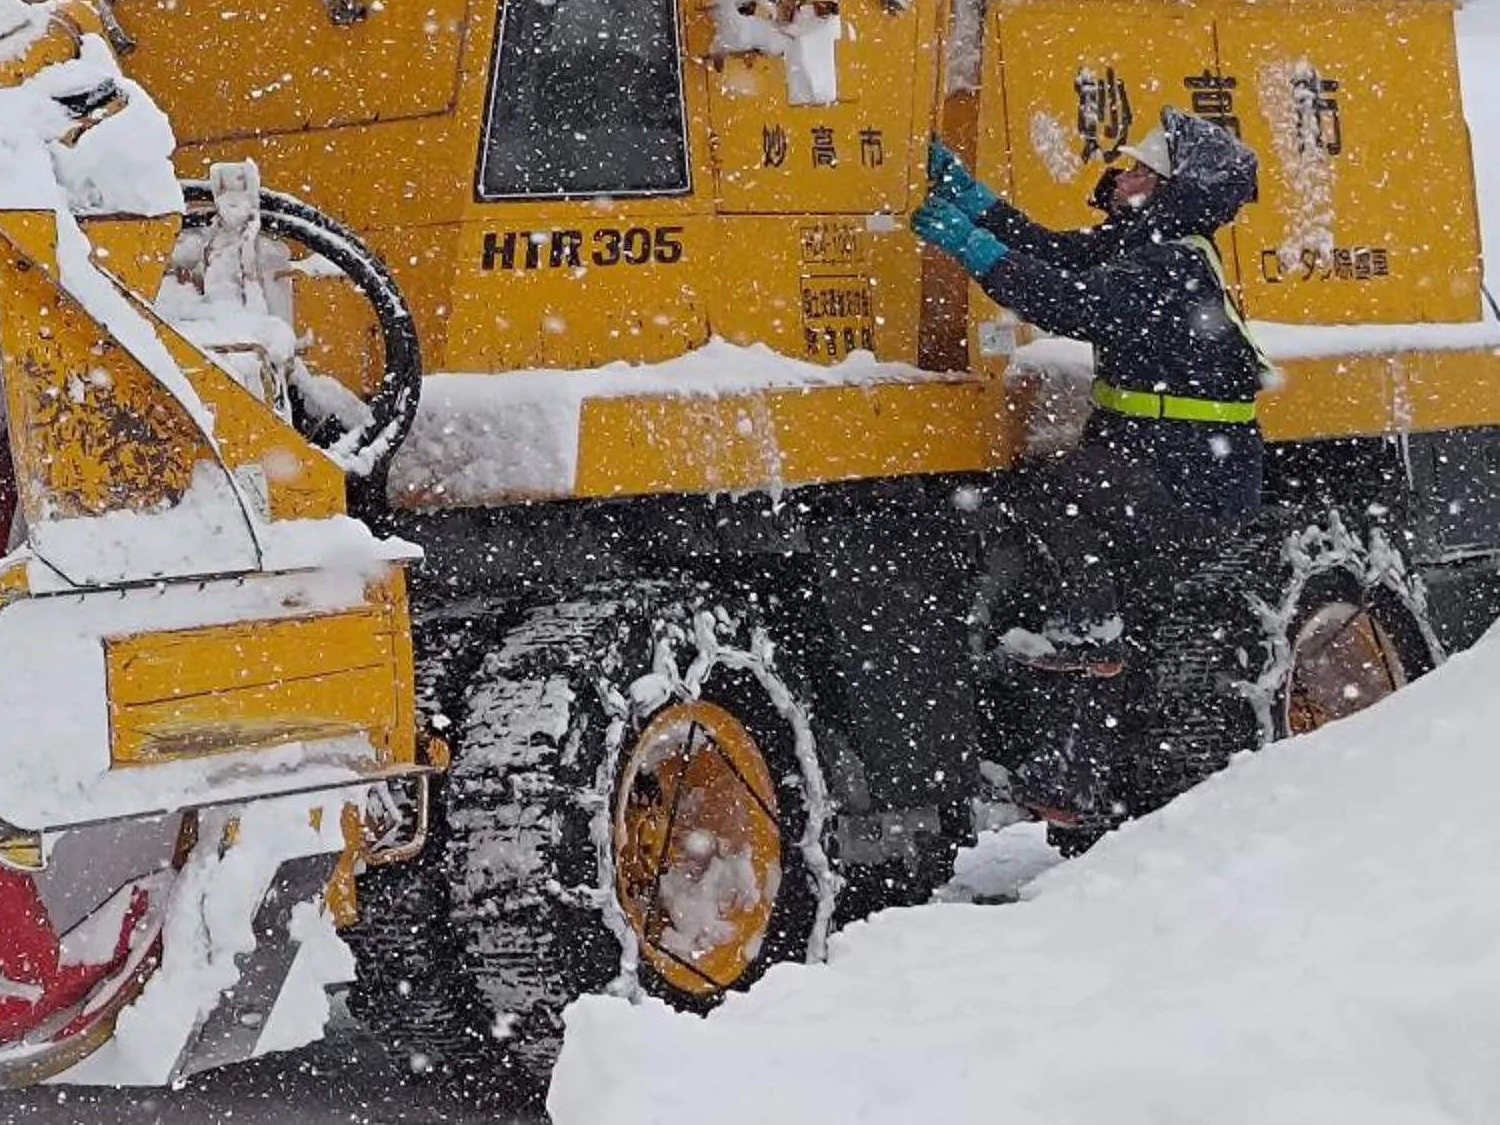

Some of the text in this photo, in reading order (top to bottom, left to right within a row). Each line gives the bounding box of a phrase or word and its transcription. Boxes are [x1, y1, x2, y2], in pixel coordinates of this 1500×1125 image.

[762, 123, 884, 169] 妙高市
[591, 225, 685, 266] 305
